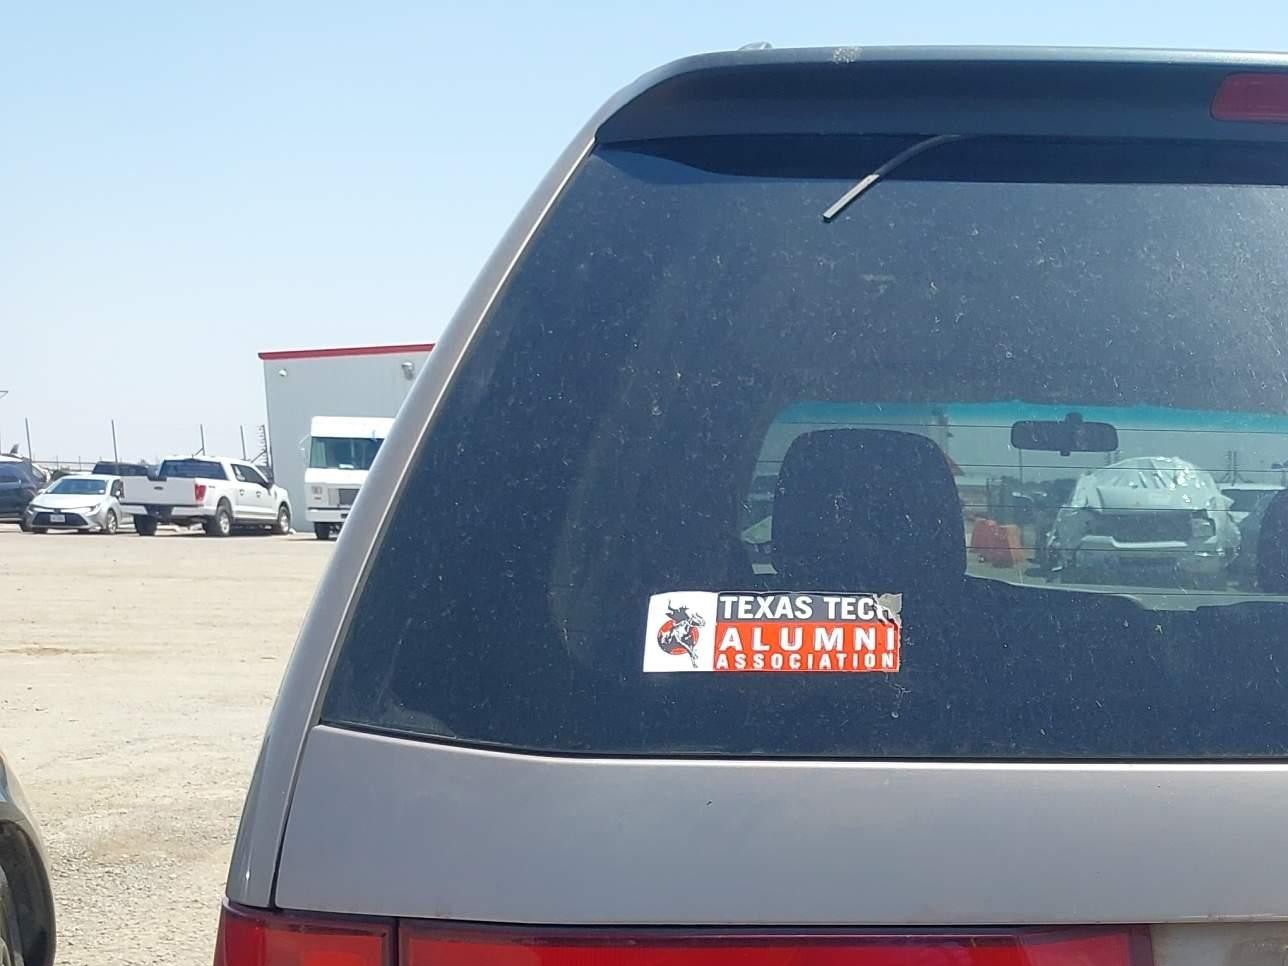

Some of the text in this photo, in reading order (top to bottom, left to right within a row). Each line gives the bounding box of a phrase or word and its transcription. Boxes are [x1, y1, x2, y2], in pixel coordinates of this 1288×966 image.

[719, 596, 813, 619] TEXAS
[719, 628, 895, 651] ALUMNI
[716, 653, 894, 669] ASSOCIATION
